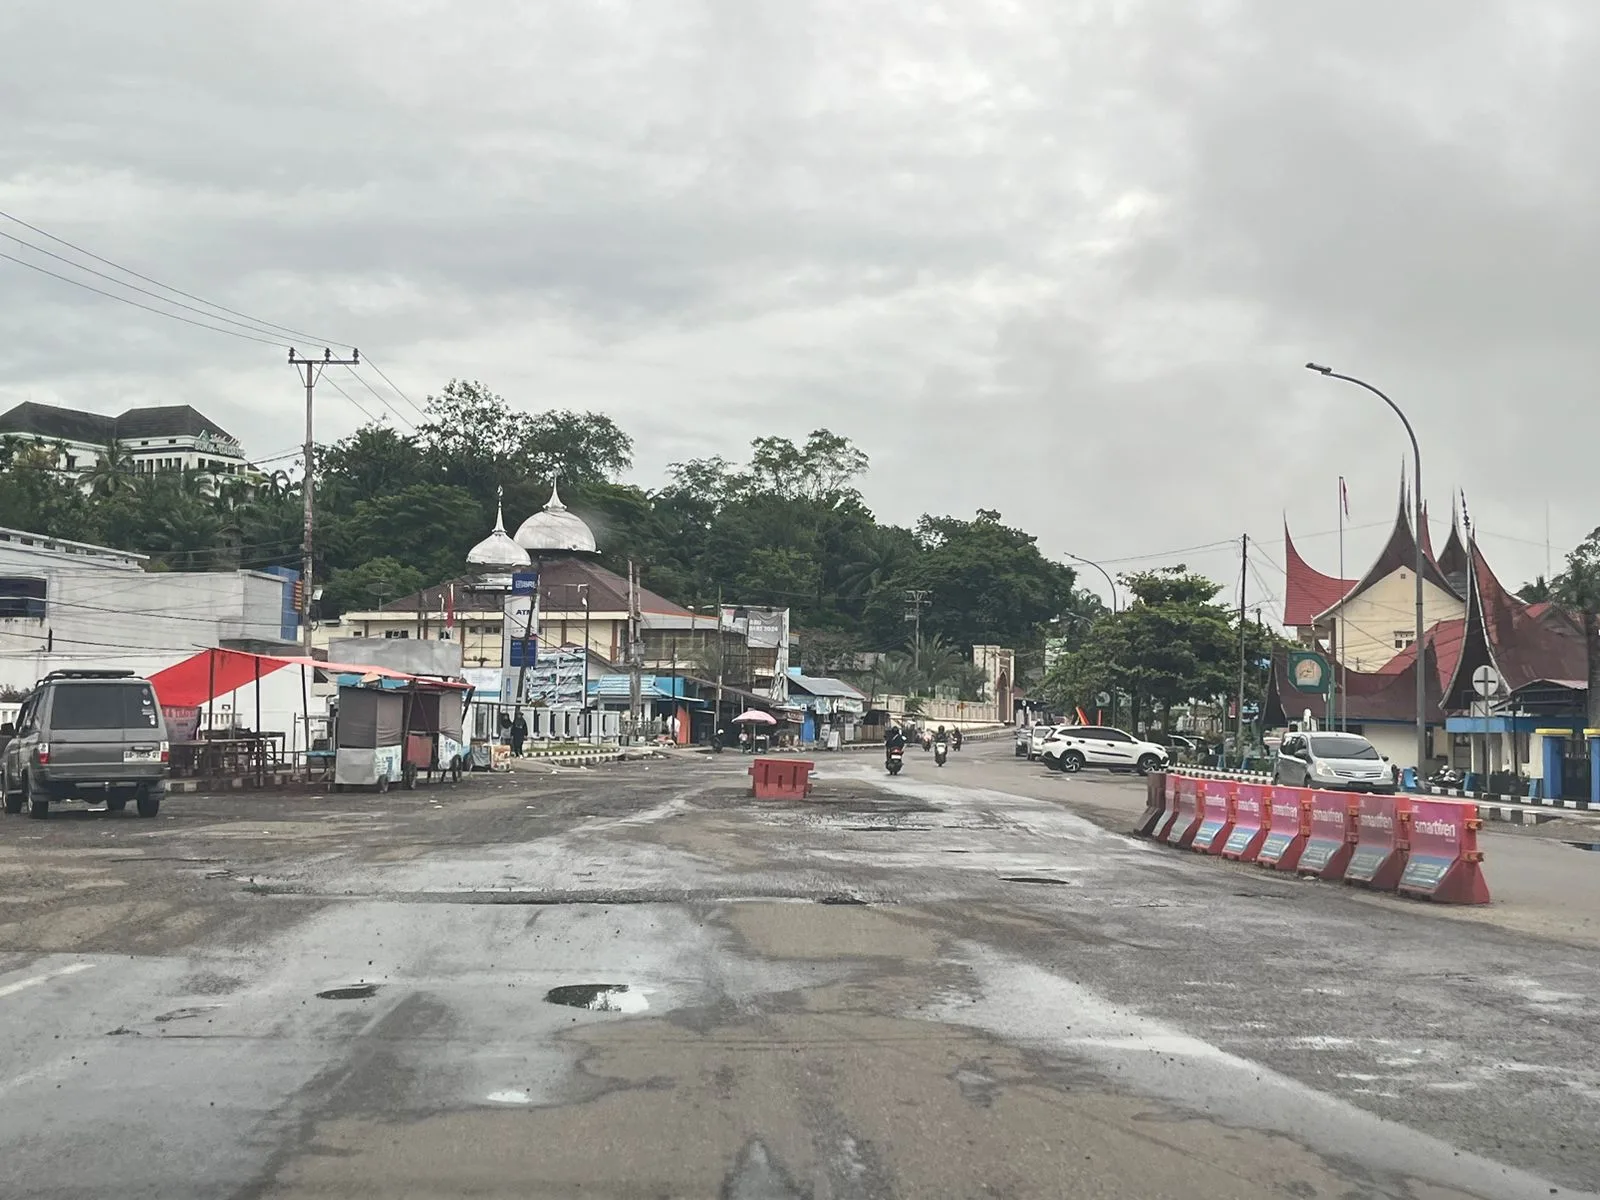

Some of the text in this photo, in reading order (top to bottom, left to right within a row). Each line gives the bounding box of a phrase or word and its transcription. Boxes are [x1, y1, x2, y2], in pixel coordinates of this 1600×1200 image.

[1273, 803, 1298, 818] smartfren
[1312, 808, 1344, 823] smartfren
[1361, 812, 1393, 828] smartfren
[1414, 819, 1455, 837] smartfren
